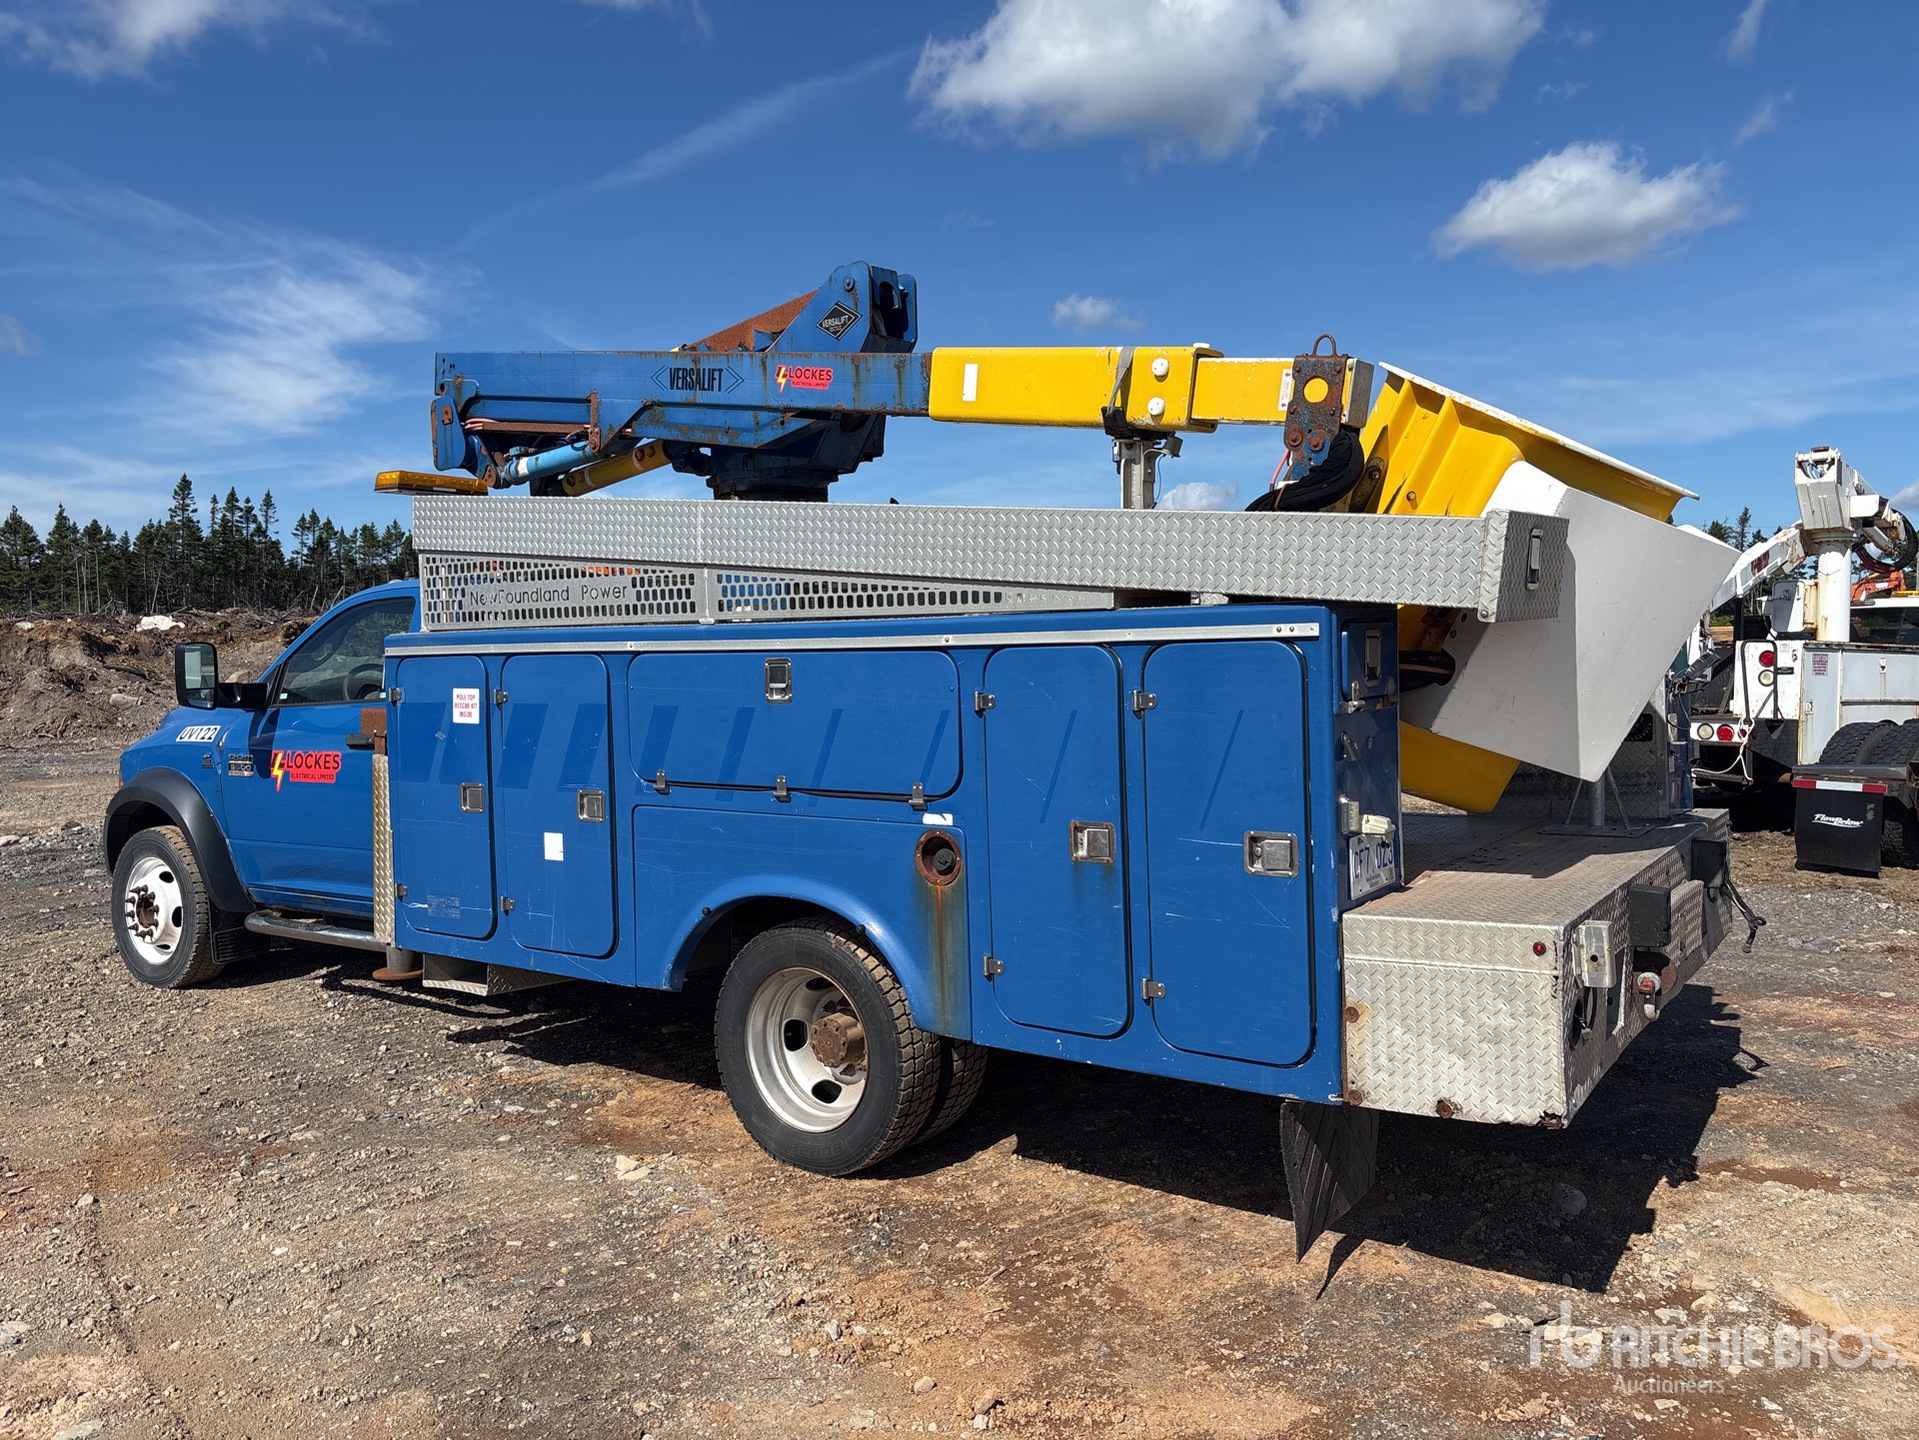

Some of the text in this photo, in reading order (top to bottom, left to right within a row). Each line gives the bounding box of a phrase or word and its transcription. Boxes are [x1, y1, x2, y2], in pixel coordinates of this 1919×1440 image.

[822, 315, 849, 328] VERSALIFT
[669, 367, 724, 392] VERSALIFT
[789, 367, 832, 381] LOCKES
[581, 585, 628, 601] Power
[454, 702, 470, 710] RESCUE
[179, 727, 218, 740] UV122
[286, 752, 340, 770] LOCKES
